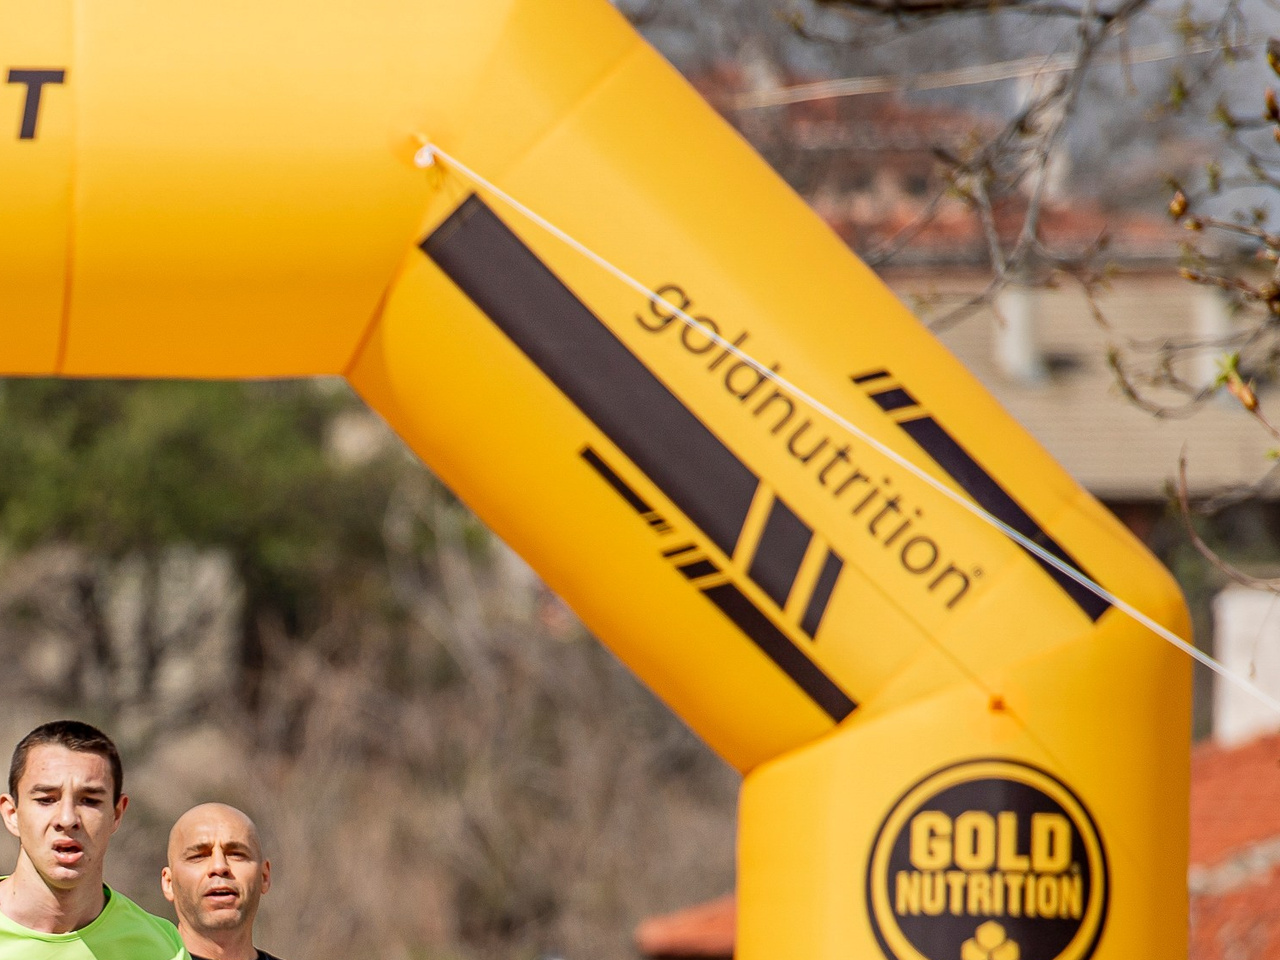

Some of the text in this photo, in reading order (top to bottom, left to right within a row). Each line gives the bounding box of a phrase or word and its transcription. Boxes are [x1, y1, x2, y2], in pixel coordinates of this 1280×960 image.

[634, 283, 973, 610] goldnutrition
[909, 810, 1073, 874] GOLD
[895, 869, 1083, 920] NUTRITION
